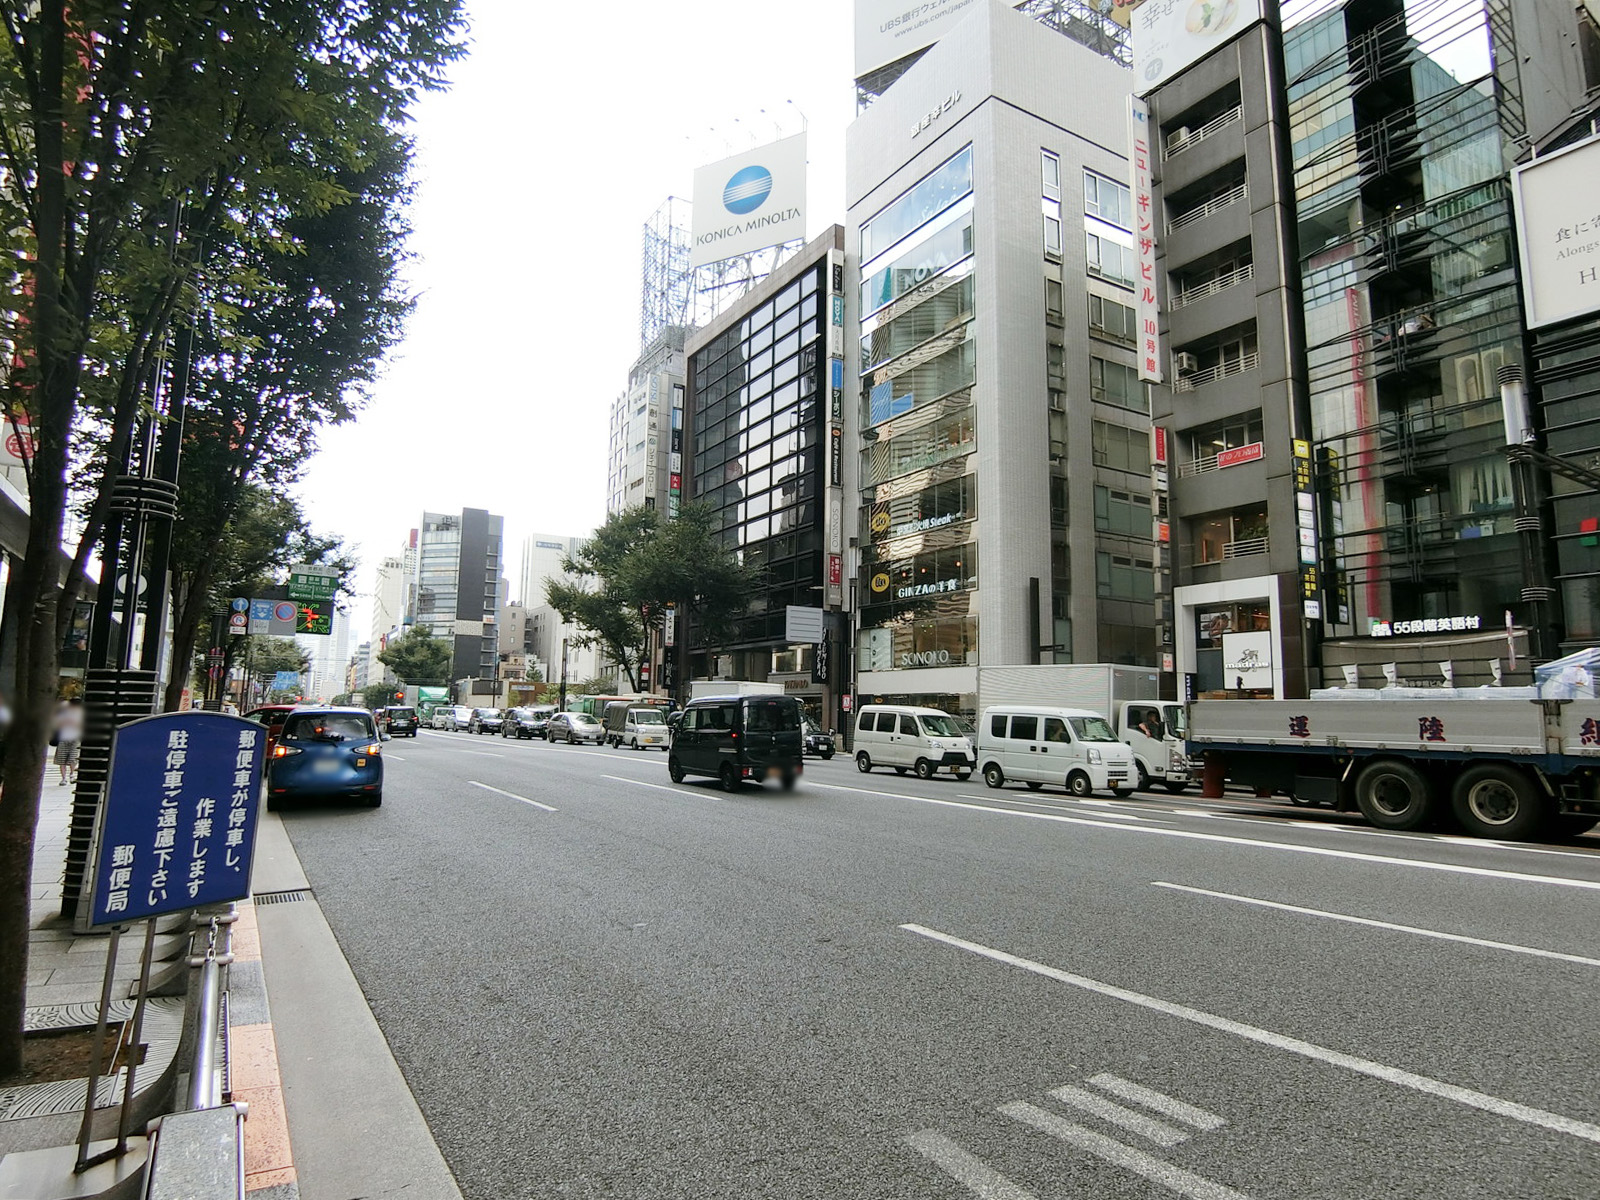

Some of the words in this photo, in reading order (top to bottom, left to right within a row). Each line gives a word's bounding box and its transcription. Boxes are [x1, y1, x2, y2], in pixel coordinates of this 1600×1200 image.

[696, 226, 742, 246] KONICA
[745, 207, 801, 232] MINOLTA
[1134, 138, 1155, 305] ニューギンザビル
[1143, 318, 1157, 374] 10号館
[831, 507, 839, 548] SONOKO
[1393, 616, 1480, 634] 55段階英語村
[901, 649, 949, 666] SONOKO
[1225, 660, 1270, 671] madras
[1288, 715, 1311, 738] 運
[1418, 716, 1446, 742] 陸
[147, 730, 189, 906] 駐停車ご遠慮下さい
[224, 729, 256, 872] 郵便車が停車し、
[186, 798, 216, 898] 作業します
[104, 844, 136, 914] 郵便局
